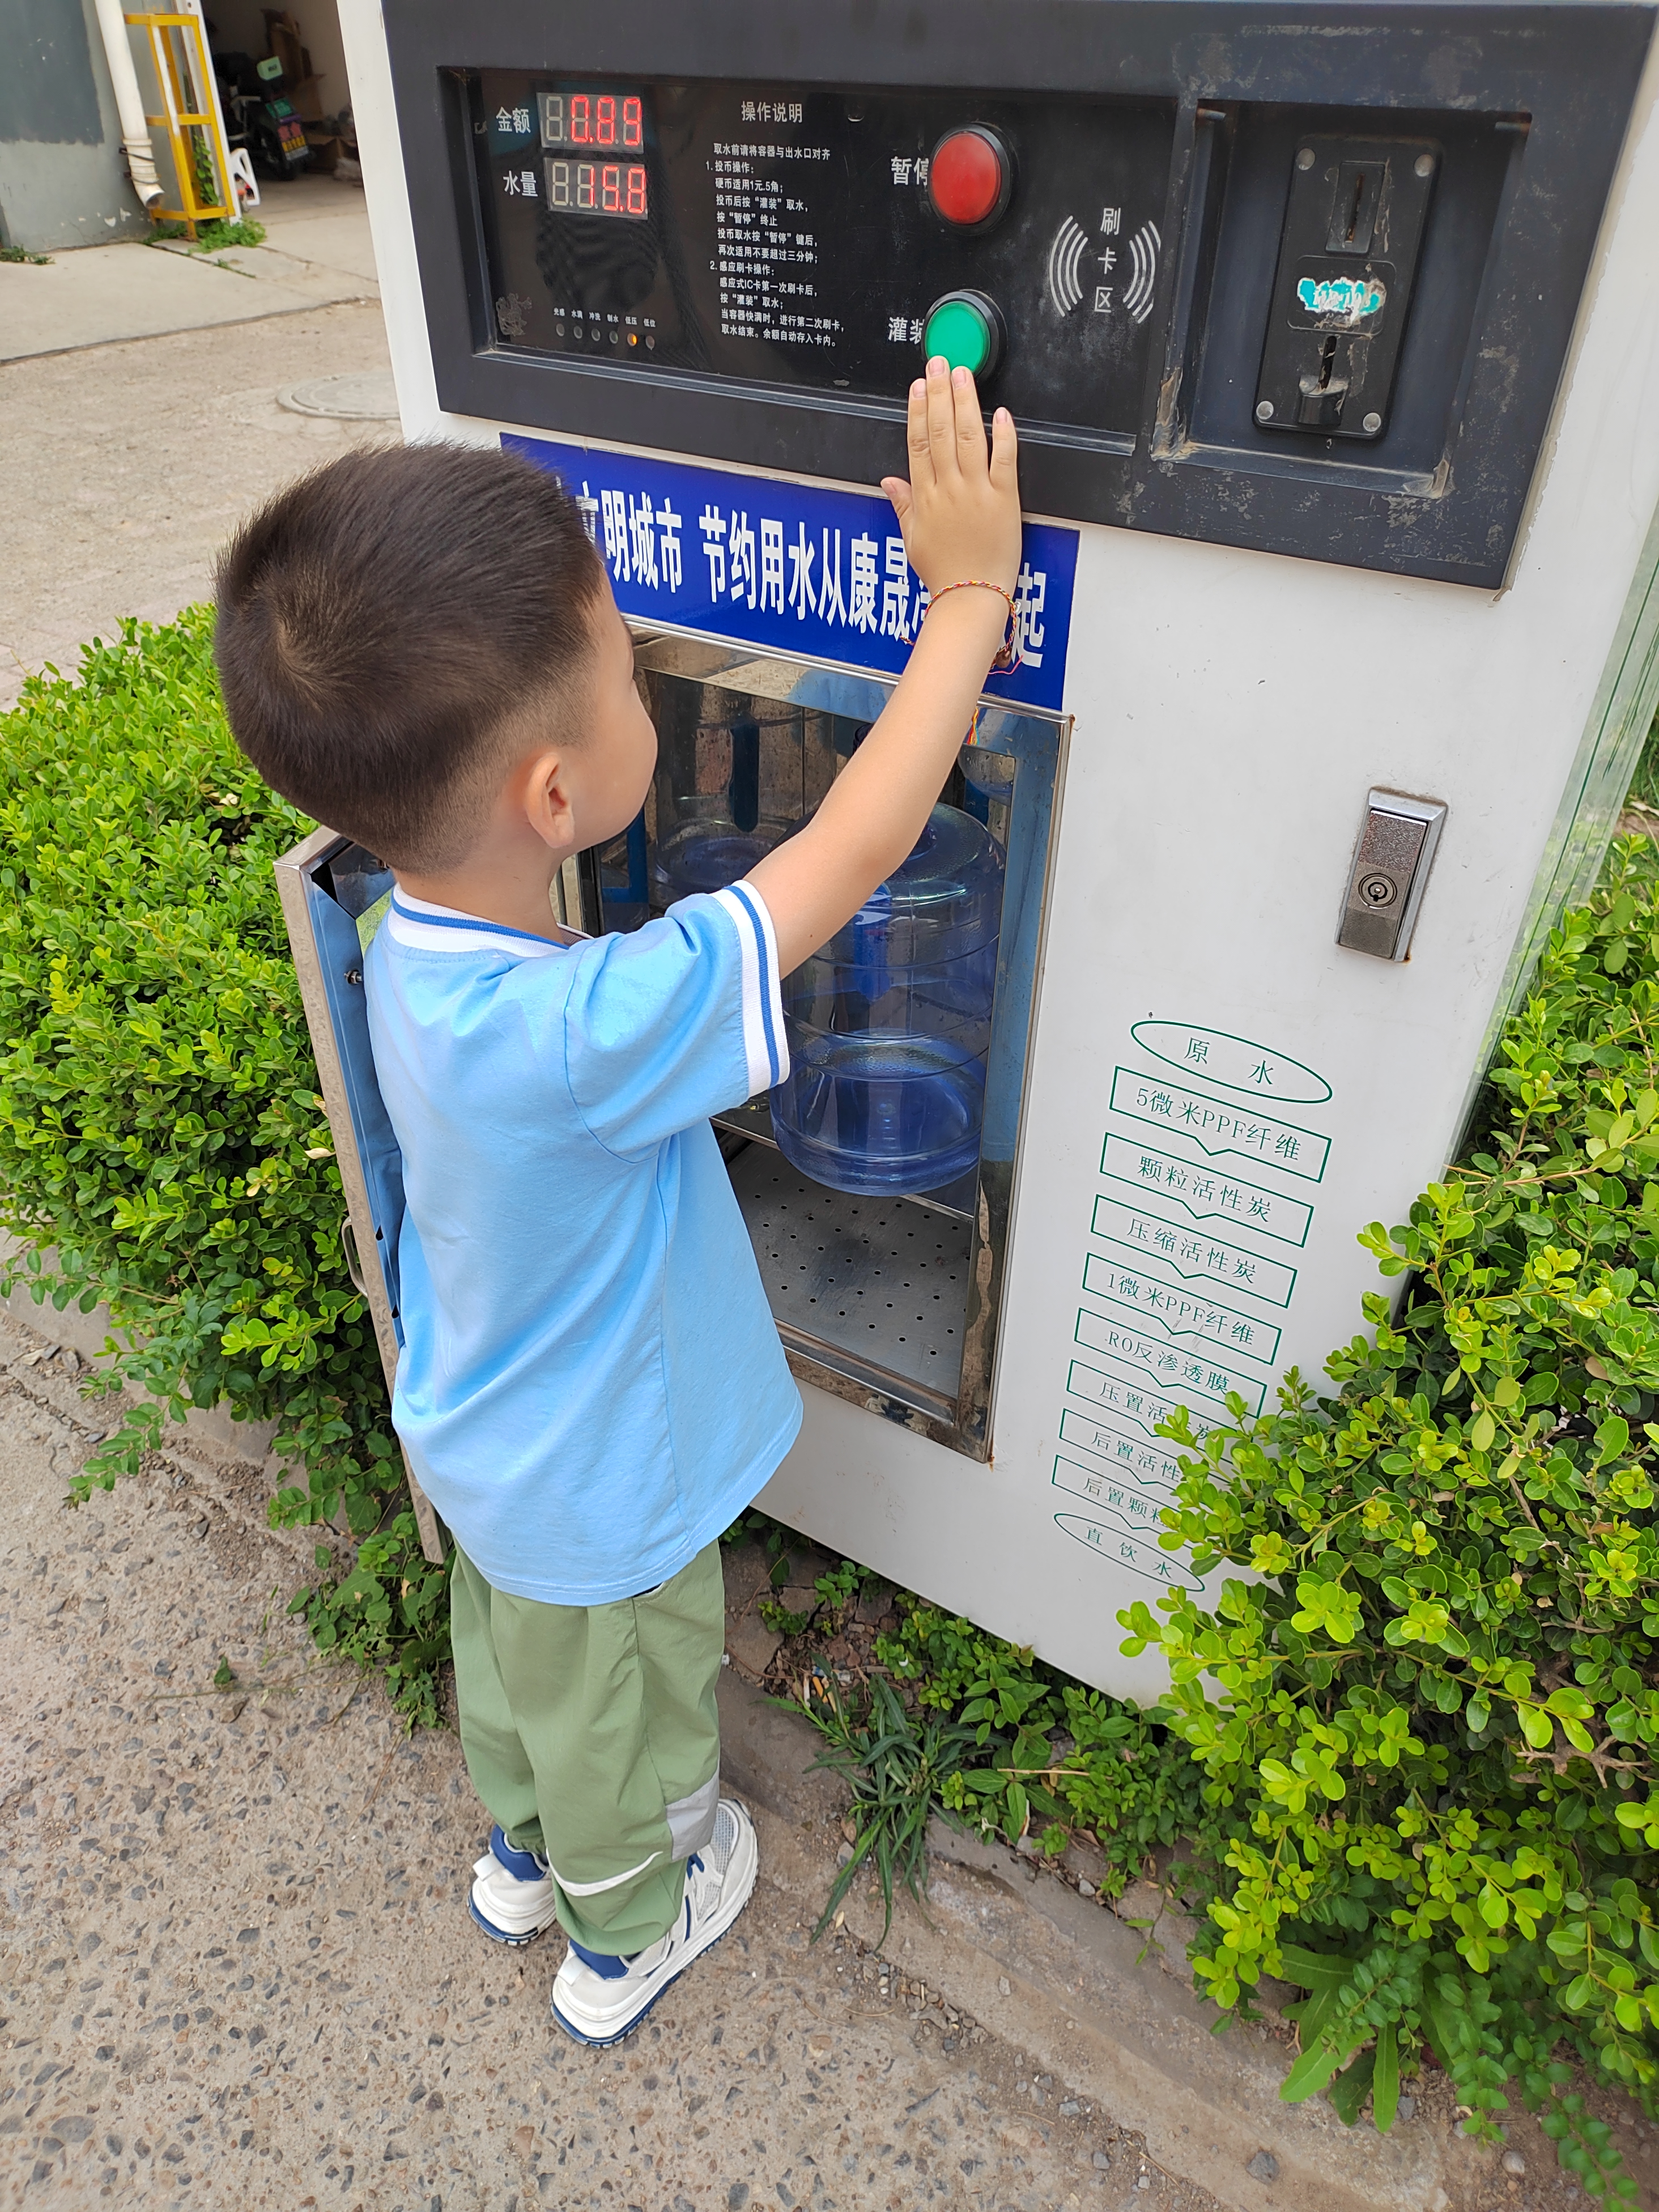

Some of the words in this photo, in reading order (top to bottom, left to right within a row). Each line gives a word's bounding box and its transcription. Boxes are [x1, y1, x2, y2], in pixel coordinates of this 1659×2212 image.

[496, 106, 531, 134] 金额
[571, 96, 641, 146] 0.89
[741, 101, 802, 123] 操作说明
[713, 143, 831, 160] 取水前请将容器与出水口对齐
[503, 170, 538, 197] 水量
[589, 165, 646, 214] 15.8
[1136, 1087, 1301, 1161] 5微米PPF纤维
[1137, 1155, 1272, 1222] 颗粒活性炭
[1126, 1218, 1257, 1284] 压缩活性炭
[1107, 1273, 1254, 1345] 1微米PPF纤维
[1107, 1330, 1230, 1395] RO反渗透膜
